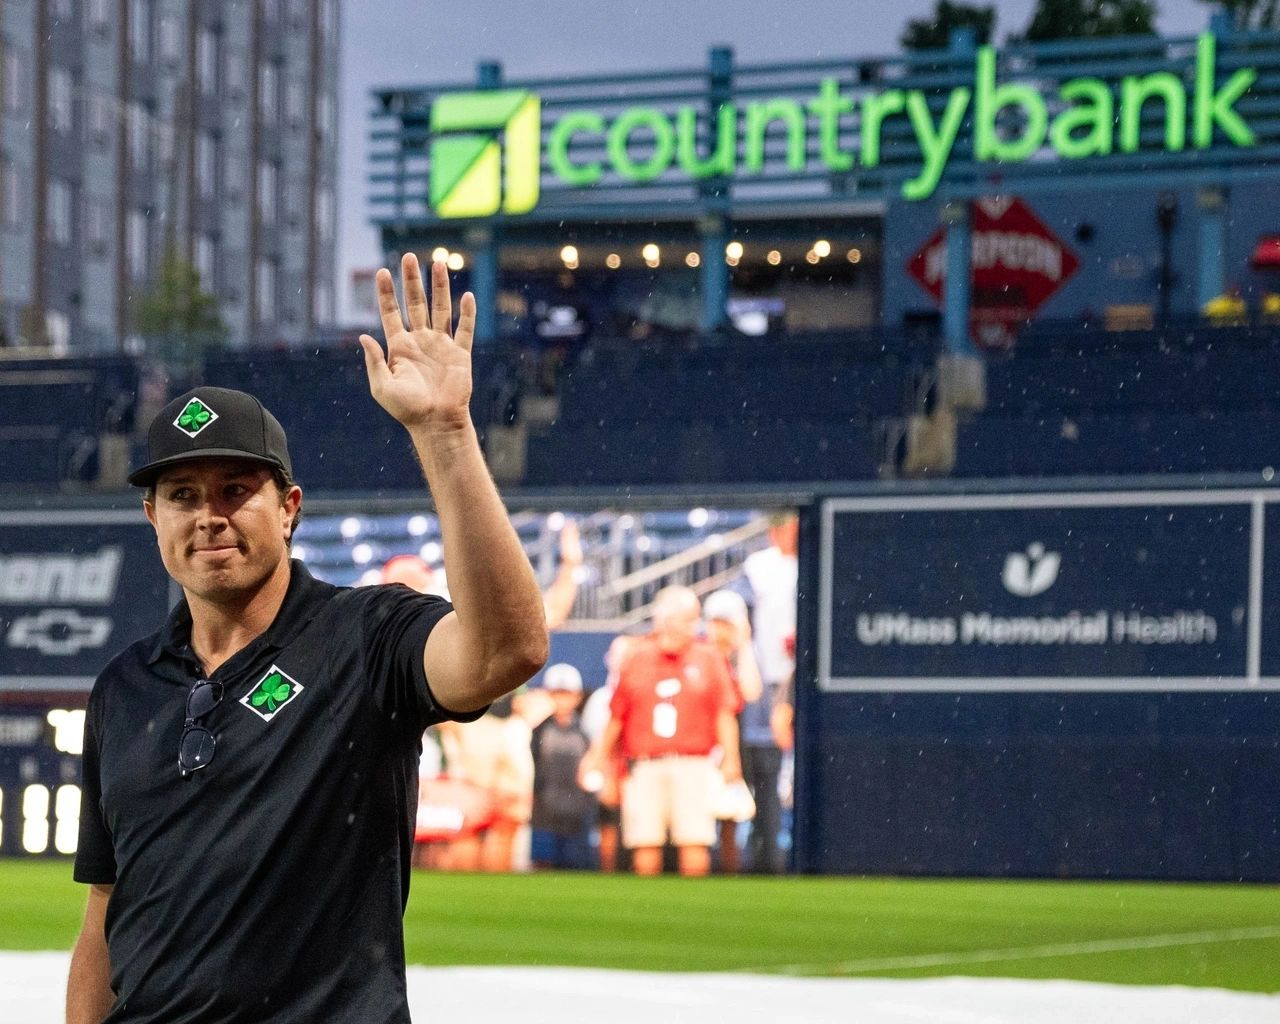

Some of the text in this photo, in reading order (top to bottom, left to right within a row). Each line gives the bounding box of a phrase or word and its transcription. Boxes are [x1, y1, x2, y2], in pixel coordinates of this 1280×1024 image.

[548, 33, 1257, 198] countrybank
[856, 610, 1218, 646] UMass Memorial Health
